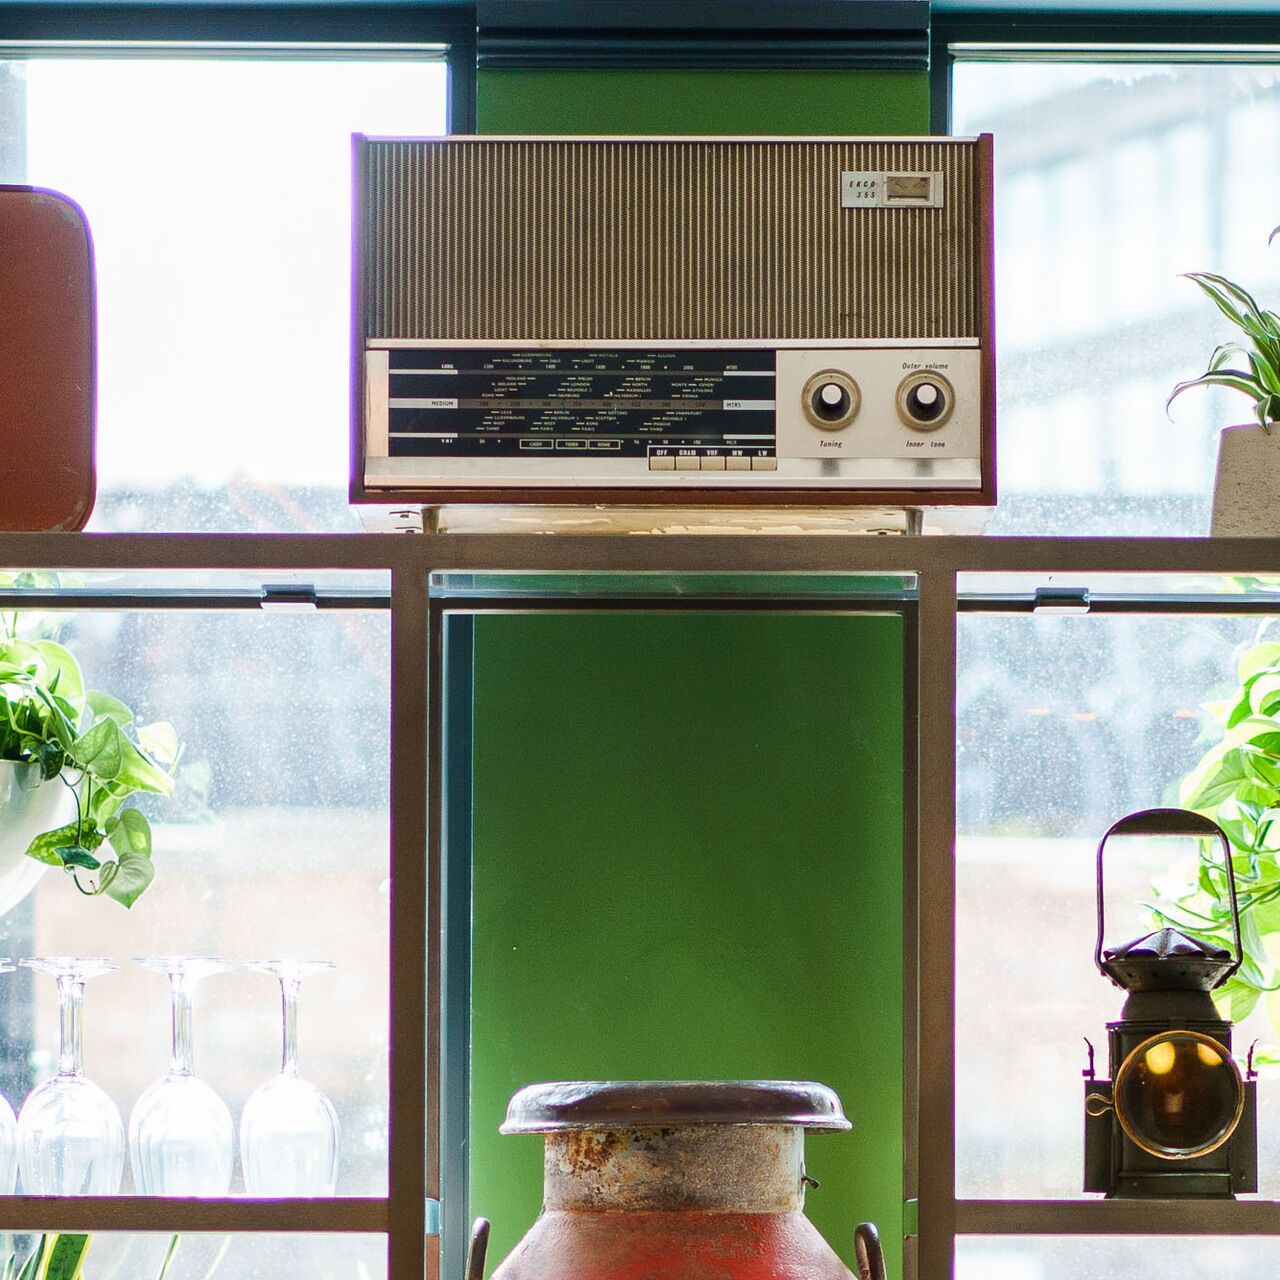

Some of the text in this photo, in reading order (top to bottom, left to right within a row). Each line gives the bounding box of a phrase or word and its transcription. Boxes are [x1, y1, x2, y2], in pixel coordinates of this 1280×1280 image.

[902, 362, 949, 370] Outer volume
[820, 440, 843, 449] Tuning
